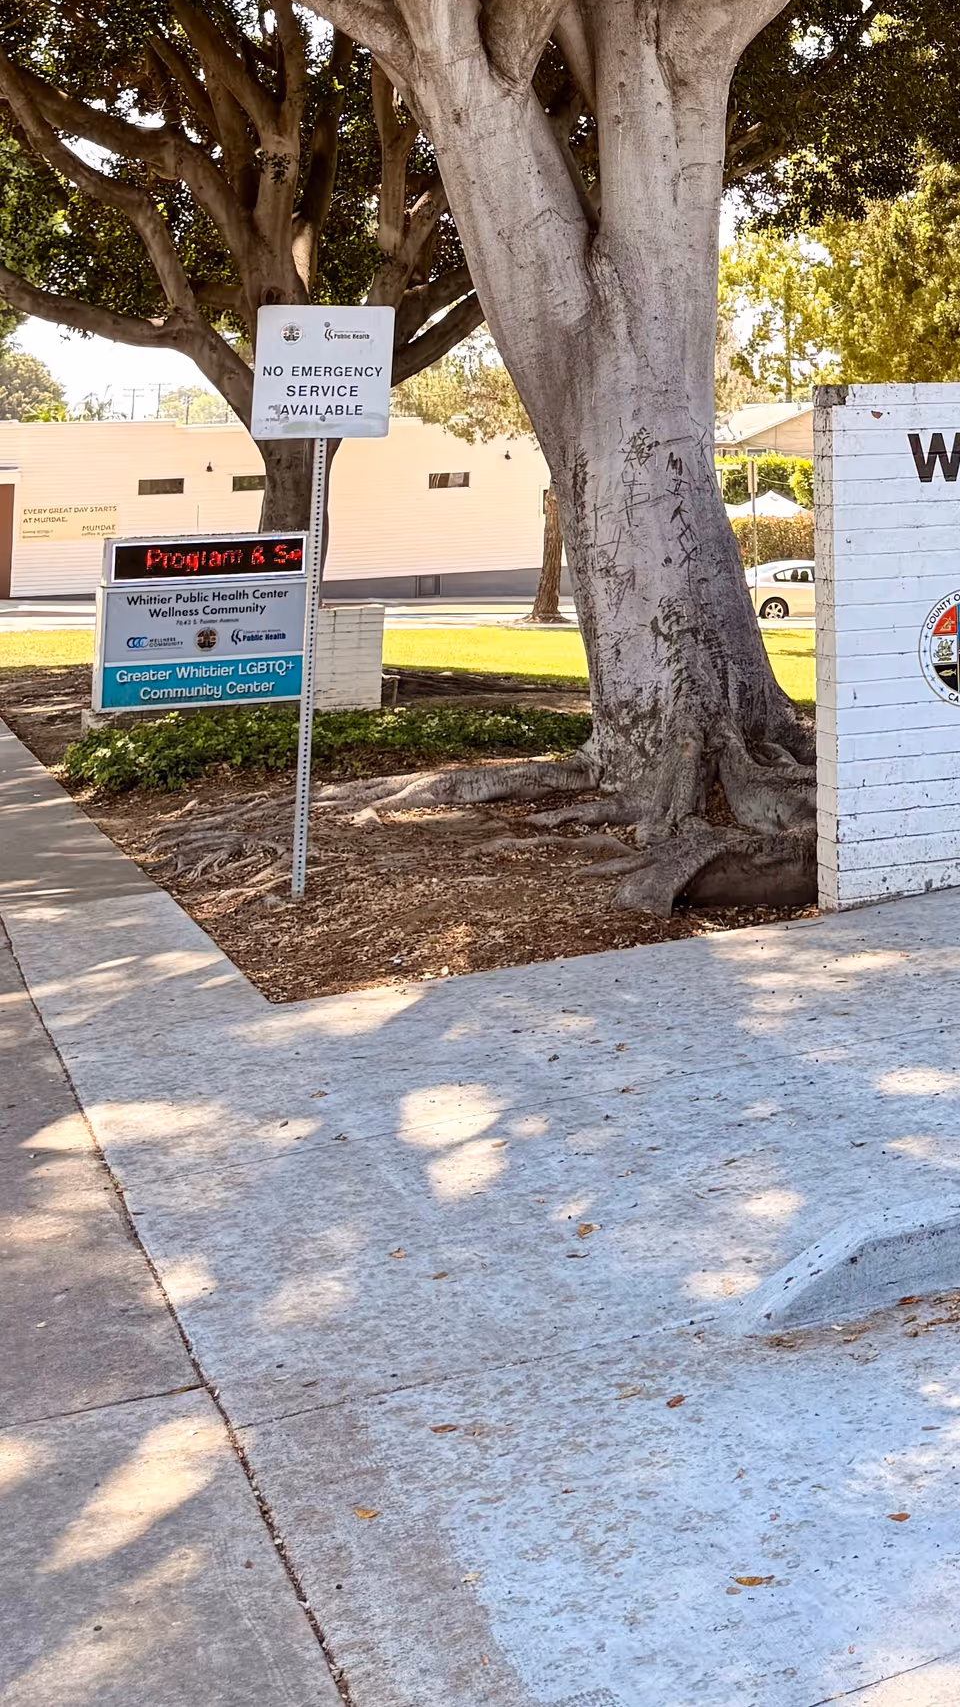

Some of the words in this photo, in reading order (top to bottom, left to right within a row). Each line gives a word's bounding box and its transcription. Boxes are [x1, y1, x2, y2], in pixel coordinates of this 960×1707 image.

[262, 366, 284, 377] NO
[291, 366, 383, 377] EMERGENCY
[286, 385, 359, 397] SERVICE
[280, 404, 364, 416] AVAILABLE
[89, 505, 118, 513] STARTS
[146, 549, 243, 571] Program
[250, 545, 265, 565] &
[126, 594, 173, 606] Whittier
[174, 592, 211, 604] Public
[213, 590, 249, 602] Health
[251, 588, 289, 600] Center
[148, 608, 200, 619] Wellness
[202, 602, 267, 617] Community
[926, 598, 952, 630] COUNTY
[264, 633, 287, 641] Health
[115, 668, 173, 684] Greater
[176, 664, 236, 680] Whittier
[238, 659, 296, 676] LGBTQ+
[139, 685, 222, 700] Community
[226, 680, 276, 694] Center
